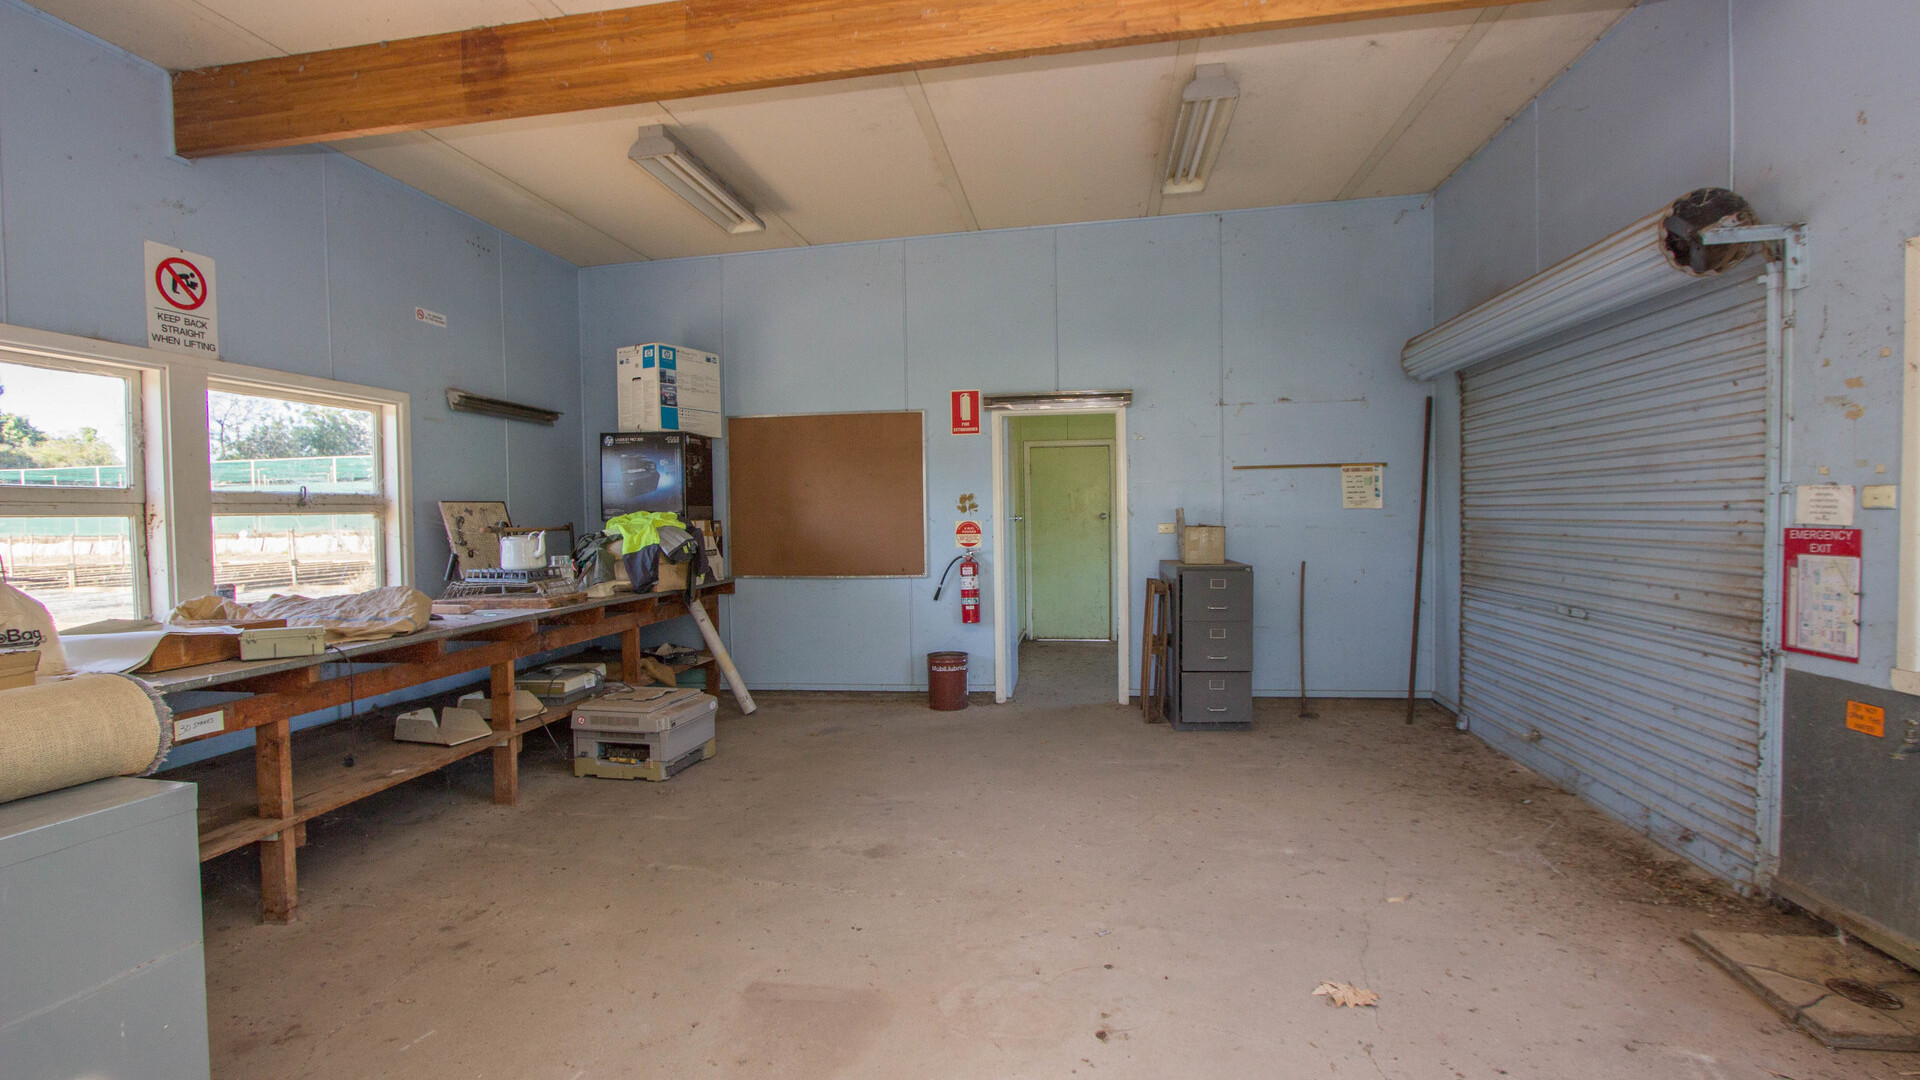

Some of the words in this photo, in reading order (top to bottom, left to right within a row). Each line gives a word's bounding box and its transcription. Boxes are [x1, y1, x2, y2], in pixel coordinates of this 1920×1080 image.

[157, 312, 181, 323] KEEP
[184, 318, 208, 329] BACK
[161, 324, 205, 339] STRAIGHT
[152, 333, 180, 345] WHEN
[184, 339, 216, 352] LIFTING
[1789, 529, 1854, 541] EMERGENCY
[1809, 543, 1833, 553] EXIT
